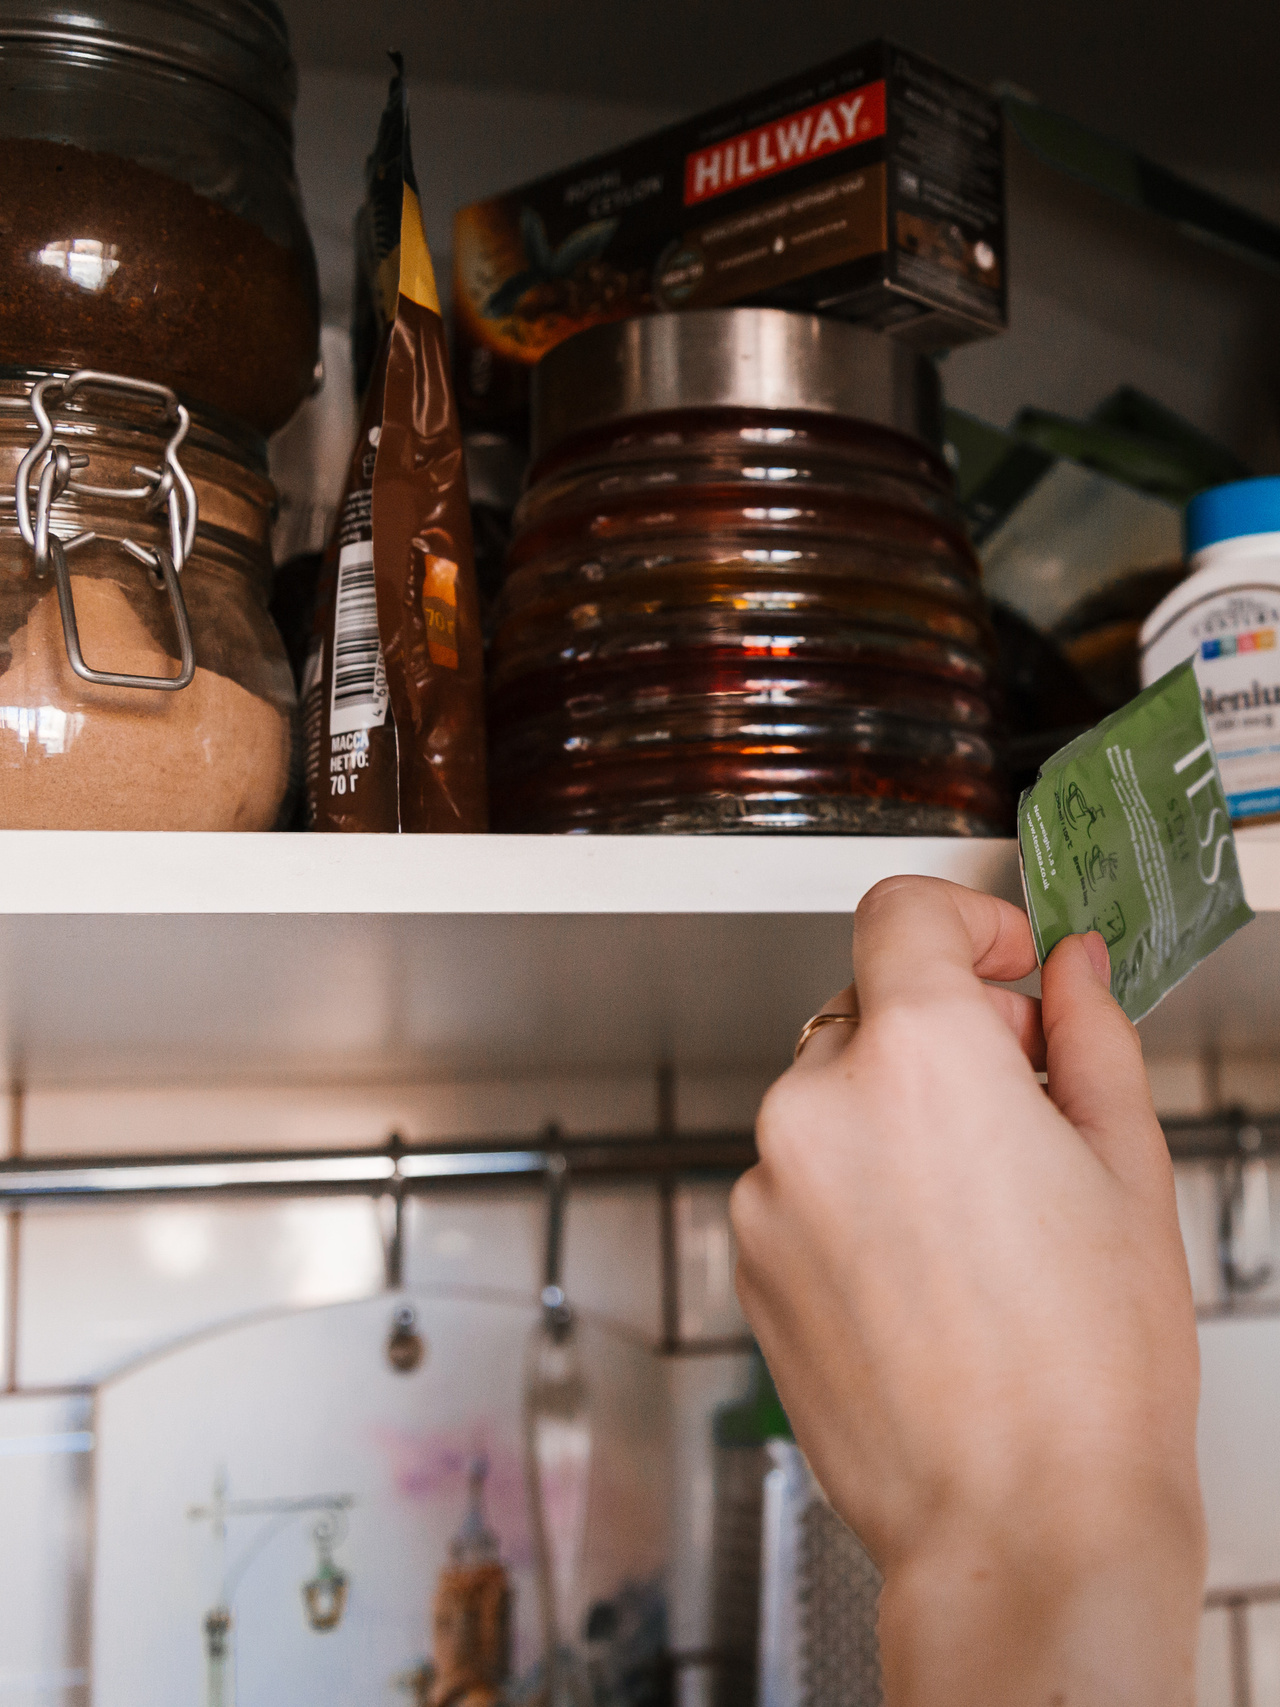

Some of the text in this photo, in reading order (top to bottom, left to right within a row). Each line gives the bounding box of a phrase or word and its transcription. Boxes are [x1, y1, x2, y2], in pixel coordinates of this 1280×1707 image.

[693, 97, 866, 194] HILLWAY
[425, 607, 443, 630] 70
[331, 730, 369, 753] МАССА
[330, 753, 369, 774] НЕТТО:
[330, 775, 347, 796] 70
[1033, 804, 1042, 821] Net
[1039, 821, 1051, 852] weight
[1026, 812, 1050, 891] www.tesstea.co.uk
[1073, 855, 1082, 876] Brew
